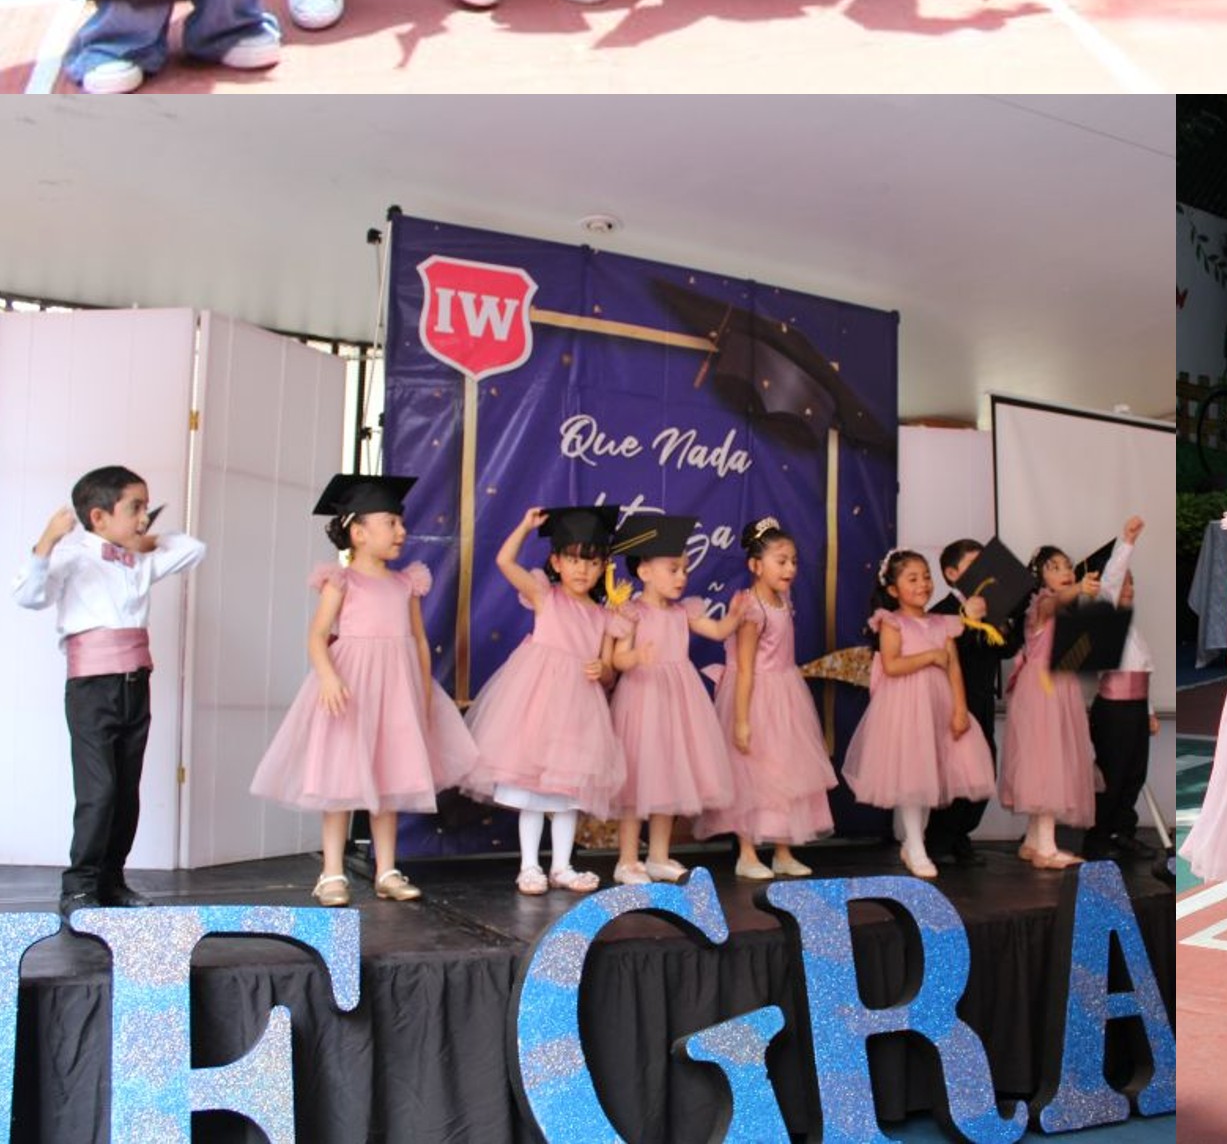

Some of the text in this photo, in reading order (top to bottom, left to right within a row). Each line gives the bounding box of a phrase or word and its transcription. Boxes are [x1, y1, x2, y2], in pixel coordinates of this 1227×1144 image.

[433, 287, 520, 342] IW
[559, 414, 752, 478] Que Nada
[517, 859, 1177, 1144] GRA
